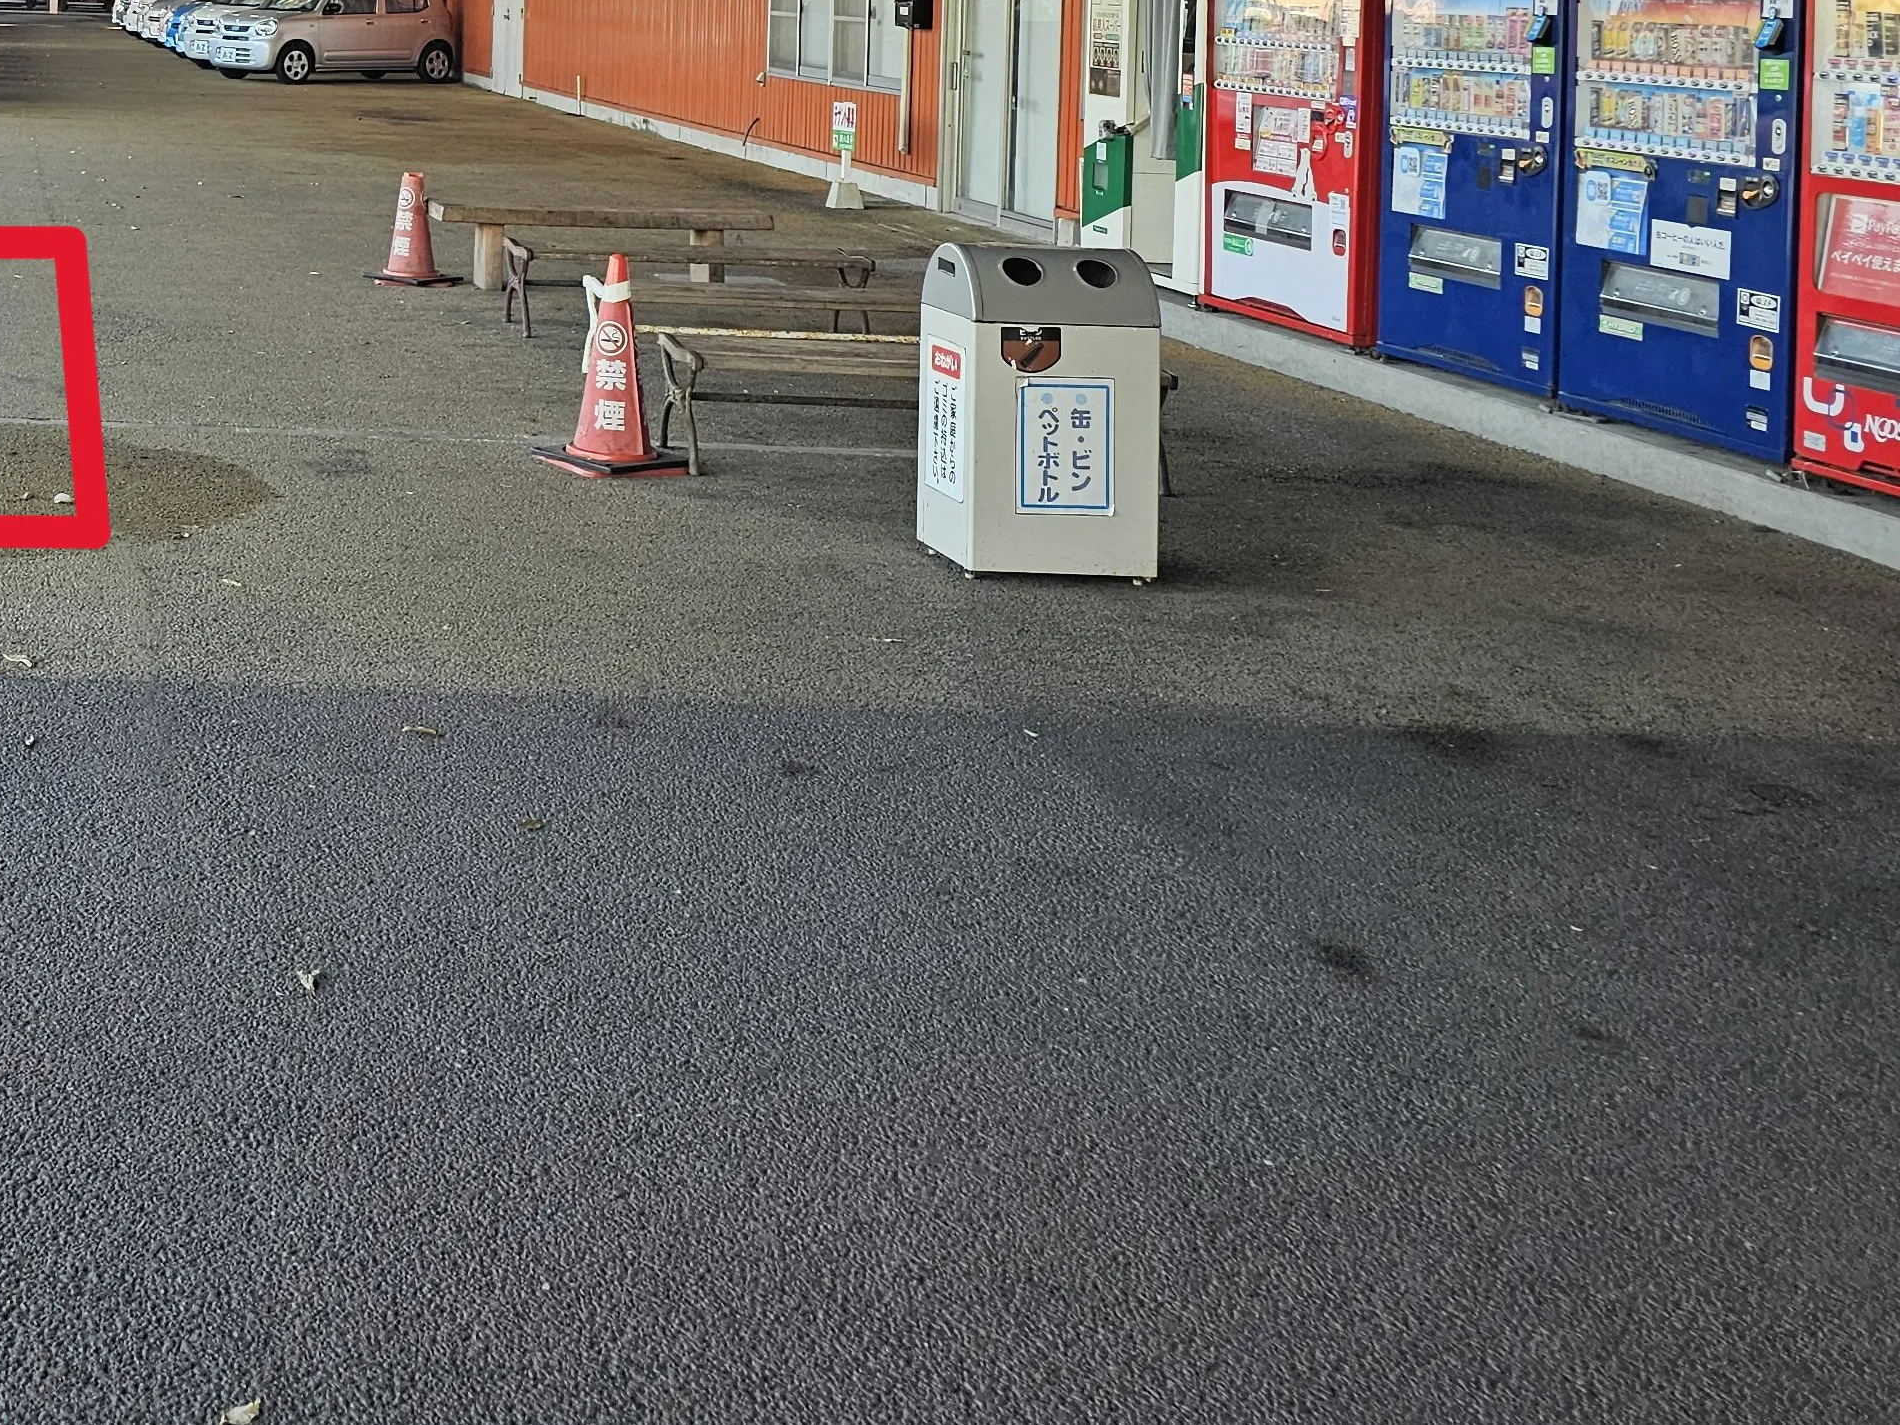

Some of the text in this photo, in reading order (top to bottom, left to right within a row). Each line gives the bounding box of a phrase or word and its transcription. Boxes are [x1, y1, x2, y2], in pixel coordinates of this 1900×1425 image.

[594, 359, 627, 431] 禁煙
[1038, 407, 1060, 503] ペットボトル
[1070, 408, 1092, 491] 缶・ビン
